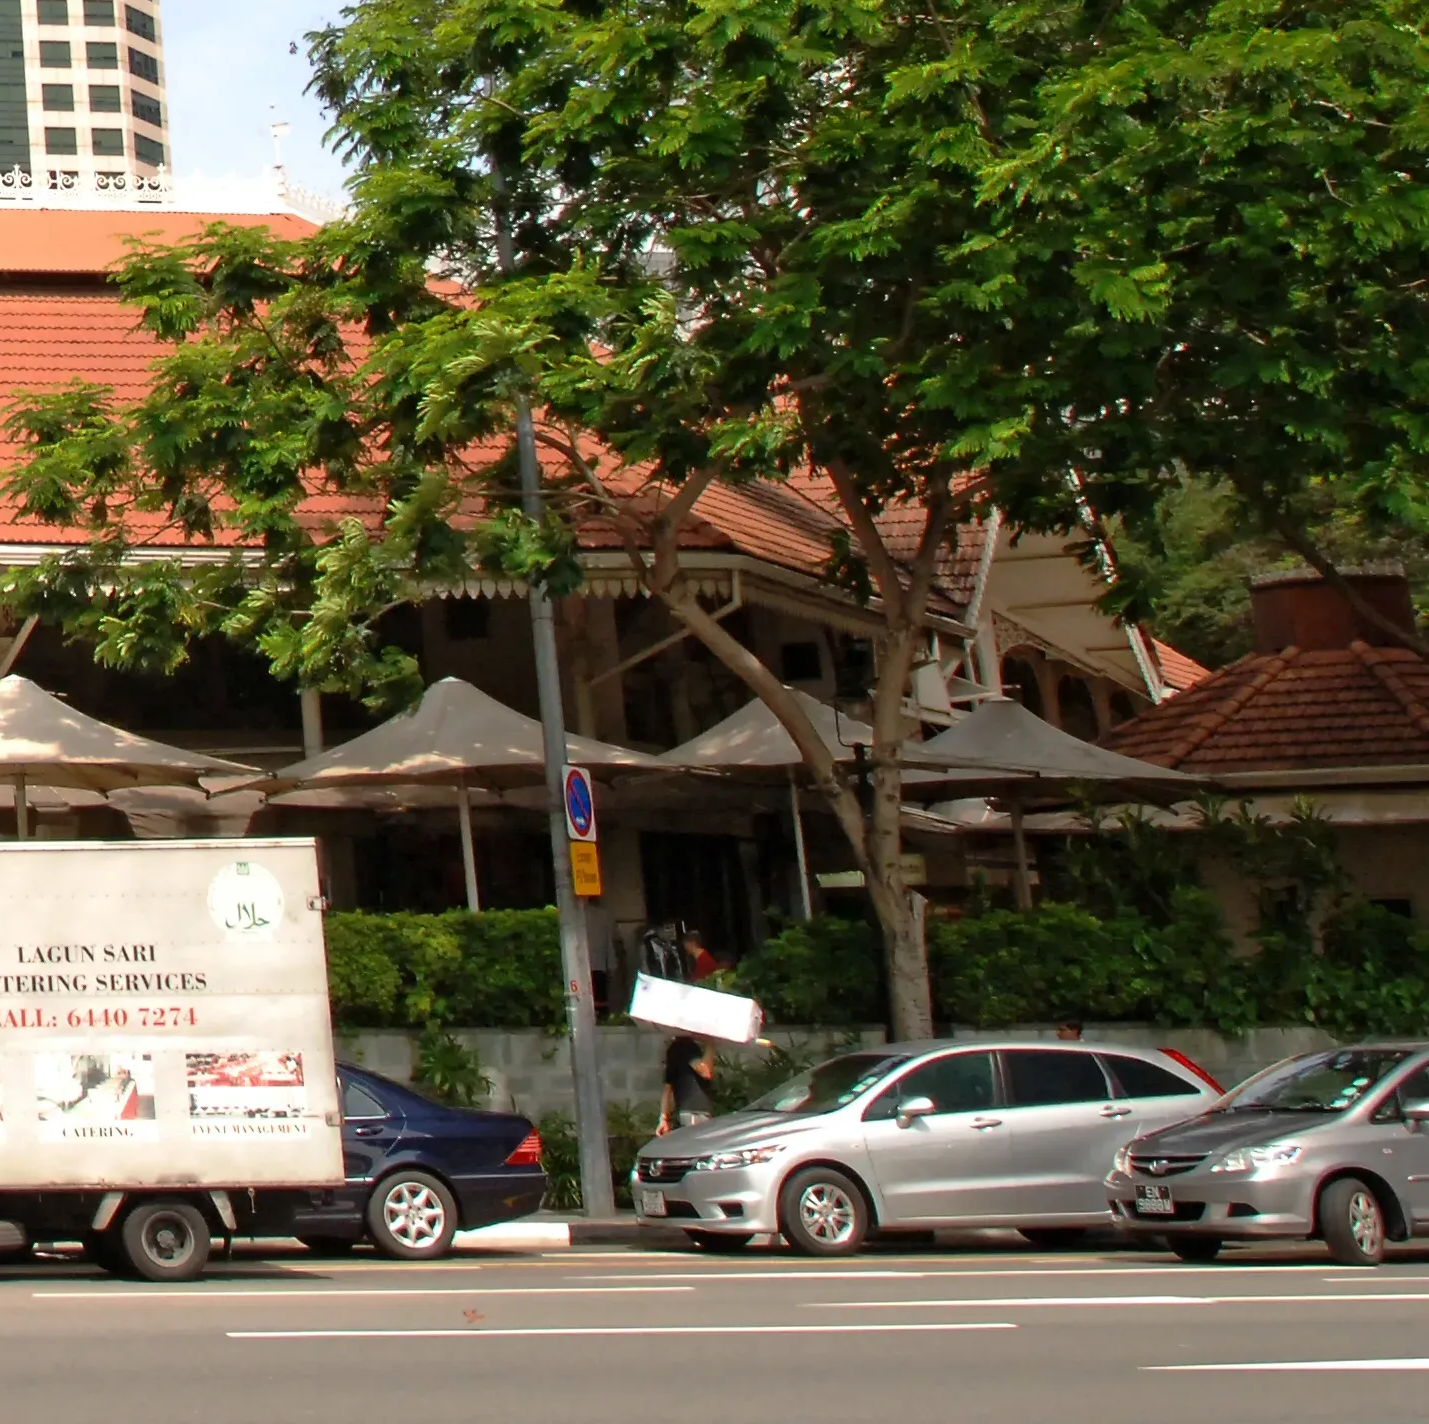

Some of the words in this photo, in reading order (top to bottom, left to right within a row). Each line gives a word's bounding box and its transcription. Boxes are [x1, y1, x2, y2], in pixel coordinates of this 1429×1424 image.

[18, 945, 95, 964] LAGUN
[103, 944, 157, 963] SARI
[95, 972, 208, 993] SERVICES
[67, 1007, 129, 1027] 6440
[138, 1006, 199, 1027] 7274
[62, 1126, 134, 1138] CATERING
